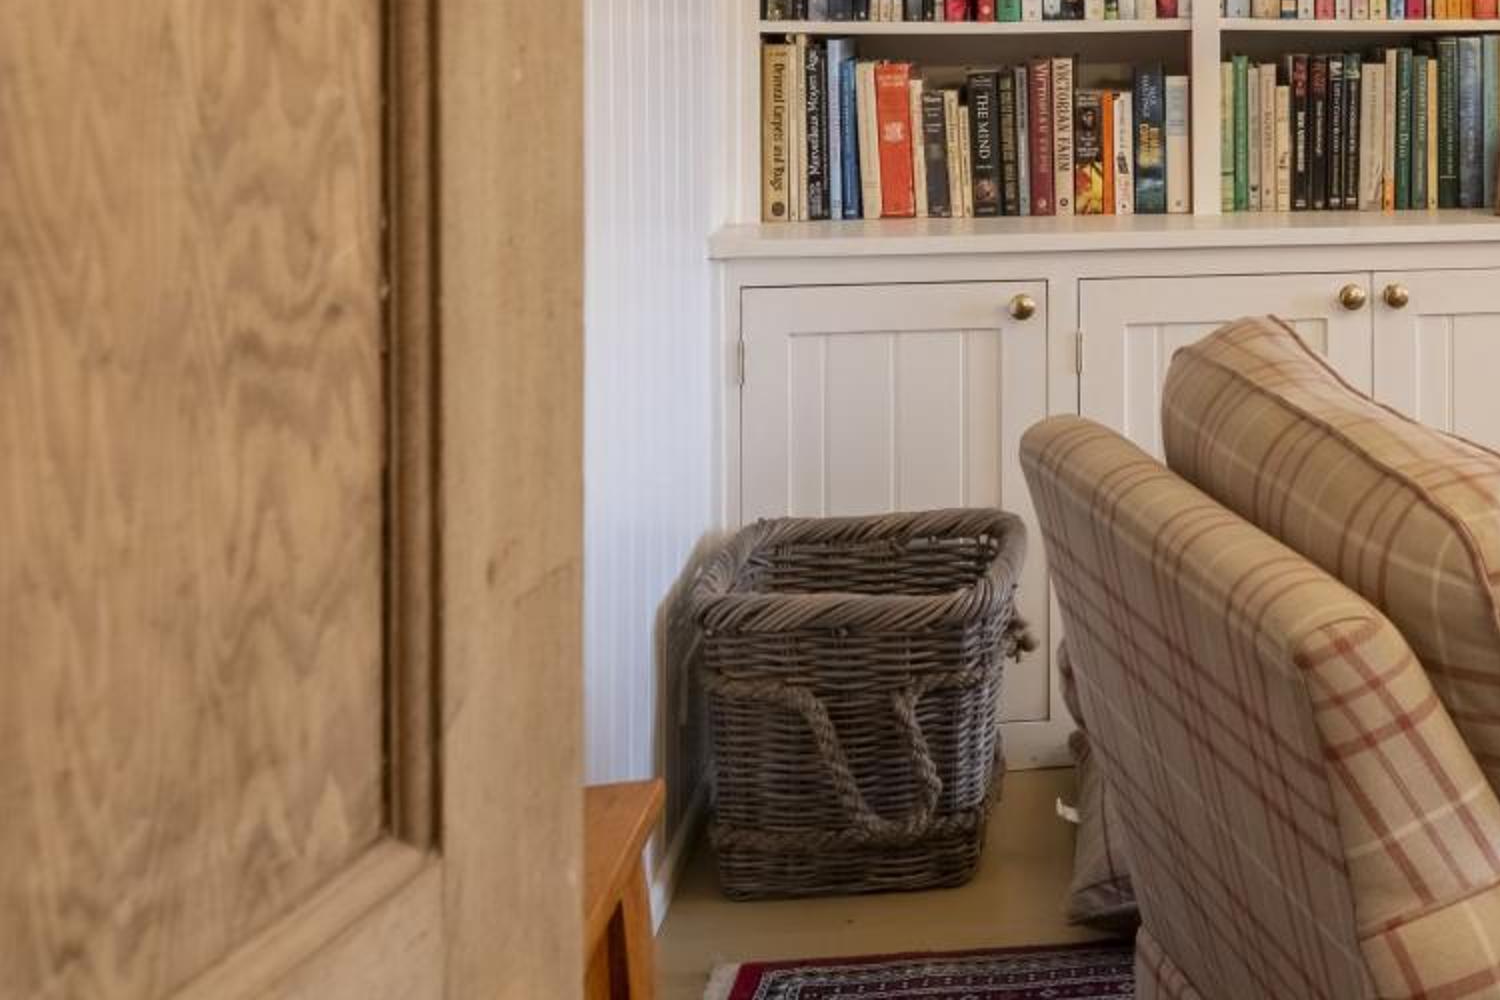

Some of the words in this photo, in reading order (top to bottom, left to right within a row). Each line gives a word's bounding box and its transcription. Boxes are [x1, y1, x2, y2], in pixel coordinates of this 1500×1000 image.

[774, 63, 785, 103] Oriental
[1056, 62, 1070, 134] VICTORIAN
[976, 94, 989, 118] THE
[977, 121, 991, 159] MIND
[1057, 137, 1070, 171] FARM
